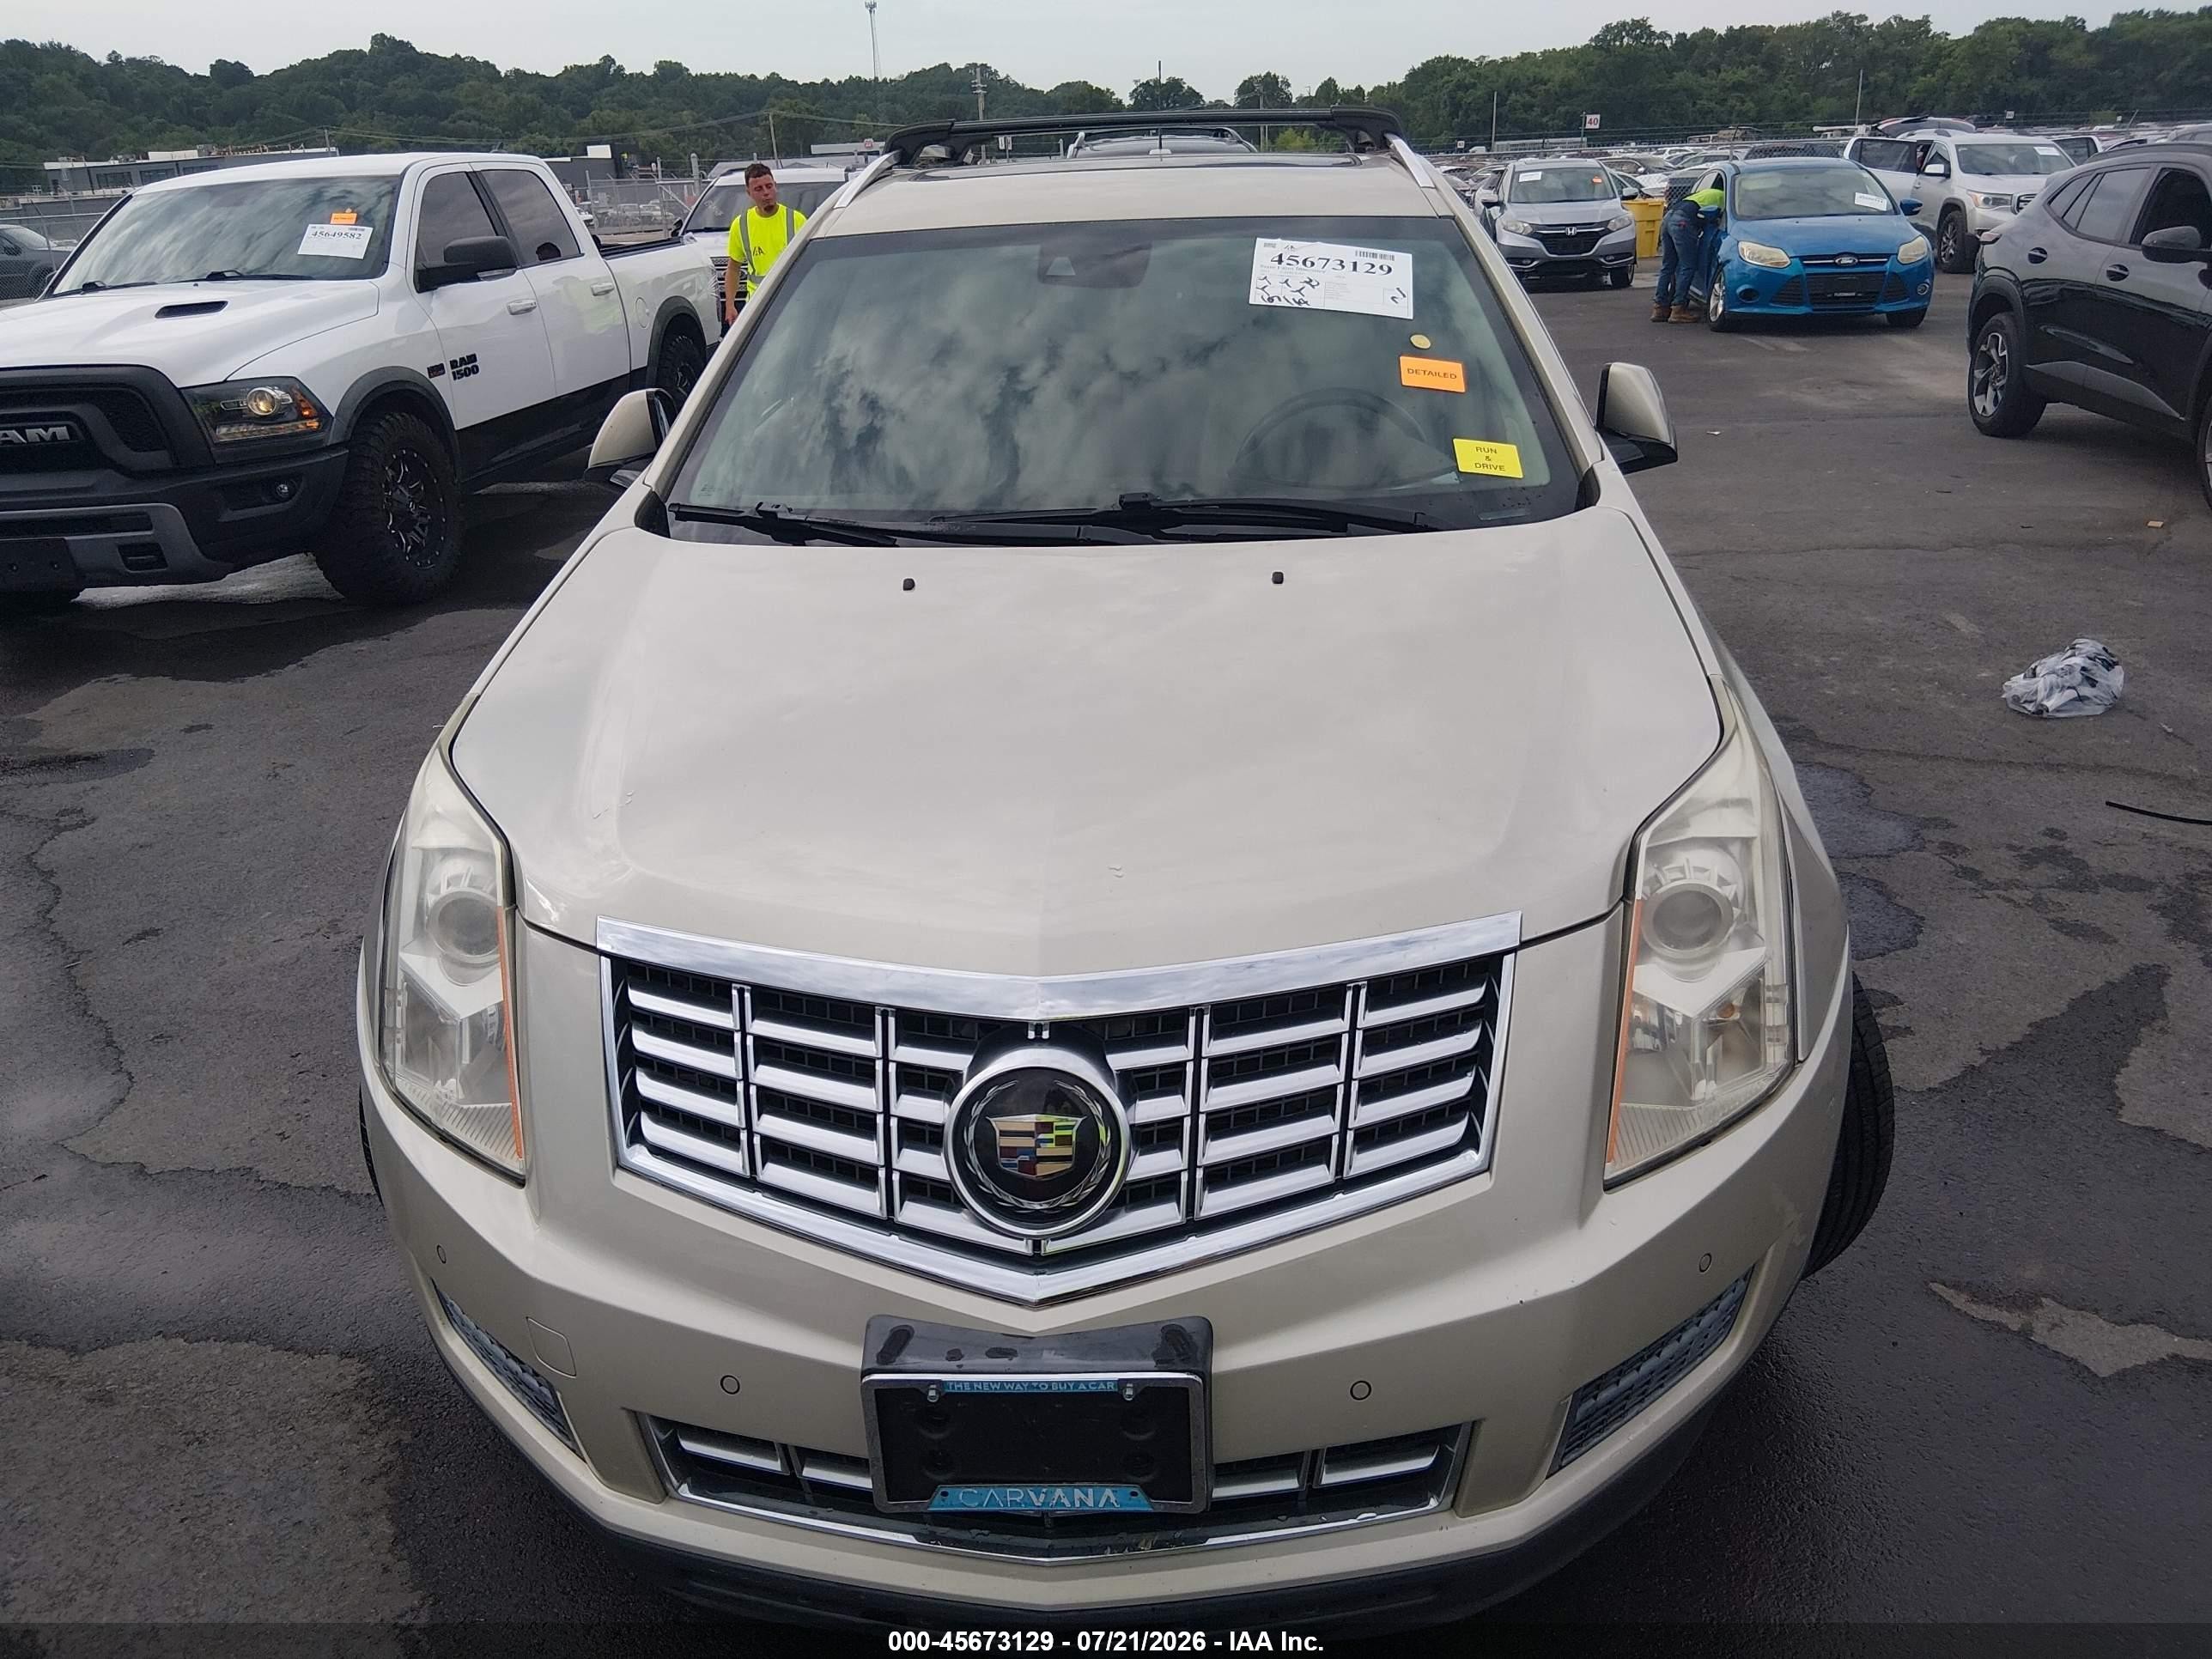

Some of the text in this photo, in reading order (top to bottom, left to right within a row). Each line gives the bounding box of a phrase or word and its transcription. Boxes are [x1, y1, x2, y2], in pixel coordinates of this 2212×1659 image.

[1587, 117, 1599, 126] 40
[1270, 252, 1394, 276] 45673129
[449, 353, 478, 370] RAM
[452, 364, 480, 381] 1500
[1407, 368, 1458, 380] DETAILED
[0, 426, 70, 443] AM
[1475, 446, 1498, 454] RUN
[1474, 462, 1506, 471] DRIVE
[947, 1381, 1115, 1391] THE NEW WAY TO BUY A CAR
[958, 1487, 1121, 1508] CARVANA
